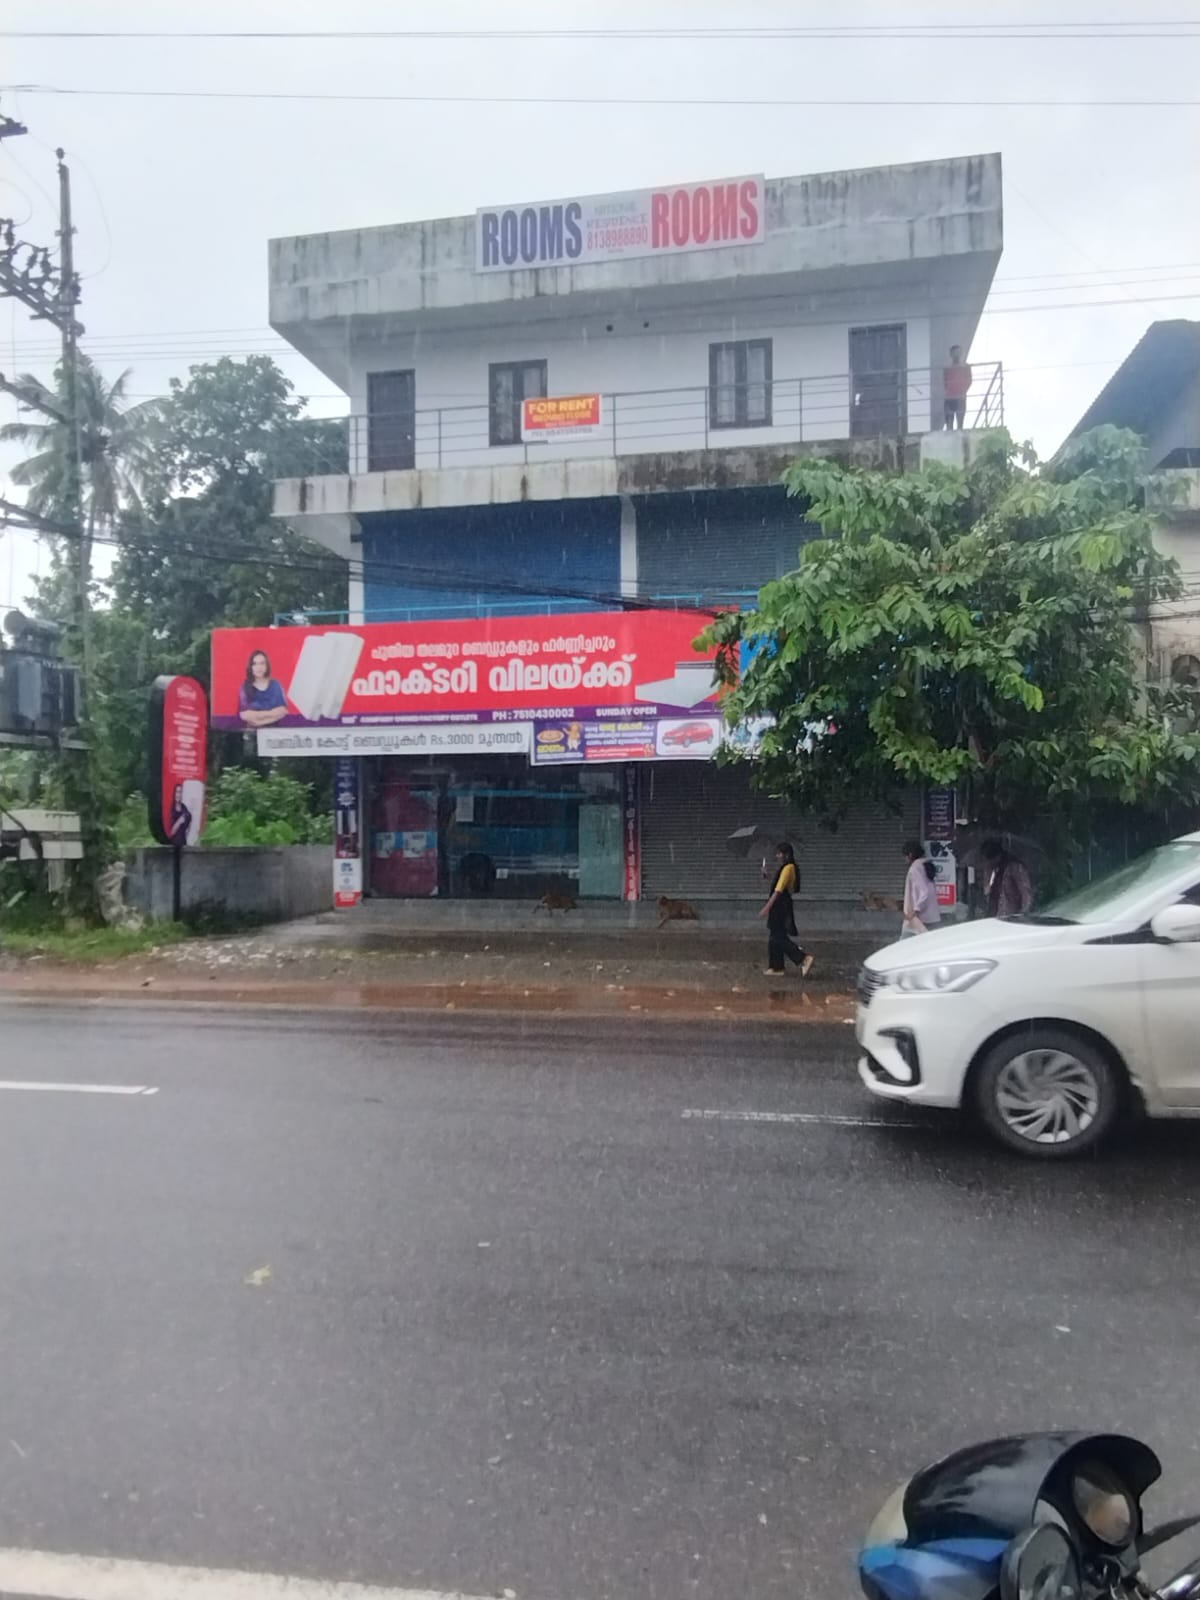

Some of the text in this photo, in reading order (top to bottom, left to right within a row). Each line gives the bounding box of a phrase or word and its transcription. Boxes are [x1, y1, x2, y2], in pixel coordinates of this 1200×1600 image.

[651, 180, 758, 249] ROOMS
[482, 202, 582, 267] ROOMS
[528, 398, 595, 415] FOR RENT
[352, 654, 637, 696] ഫാക്ടറി വിലയ്ക്ക്
[596, 706, 657, 718] SUNDAY OPEN
[430, 733, 474, 745] Rs.3000
